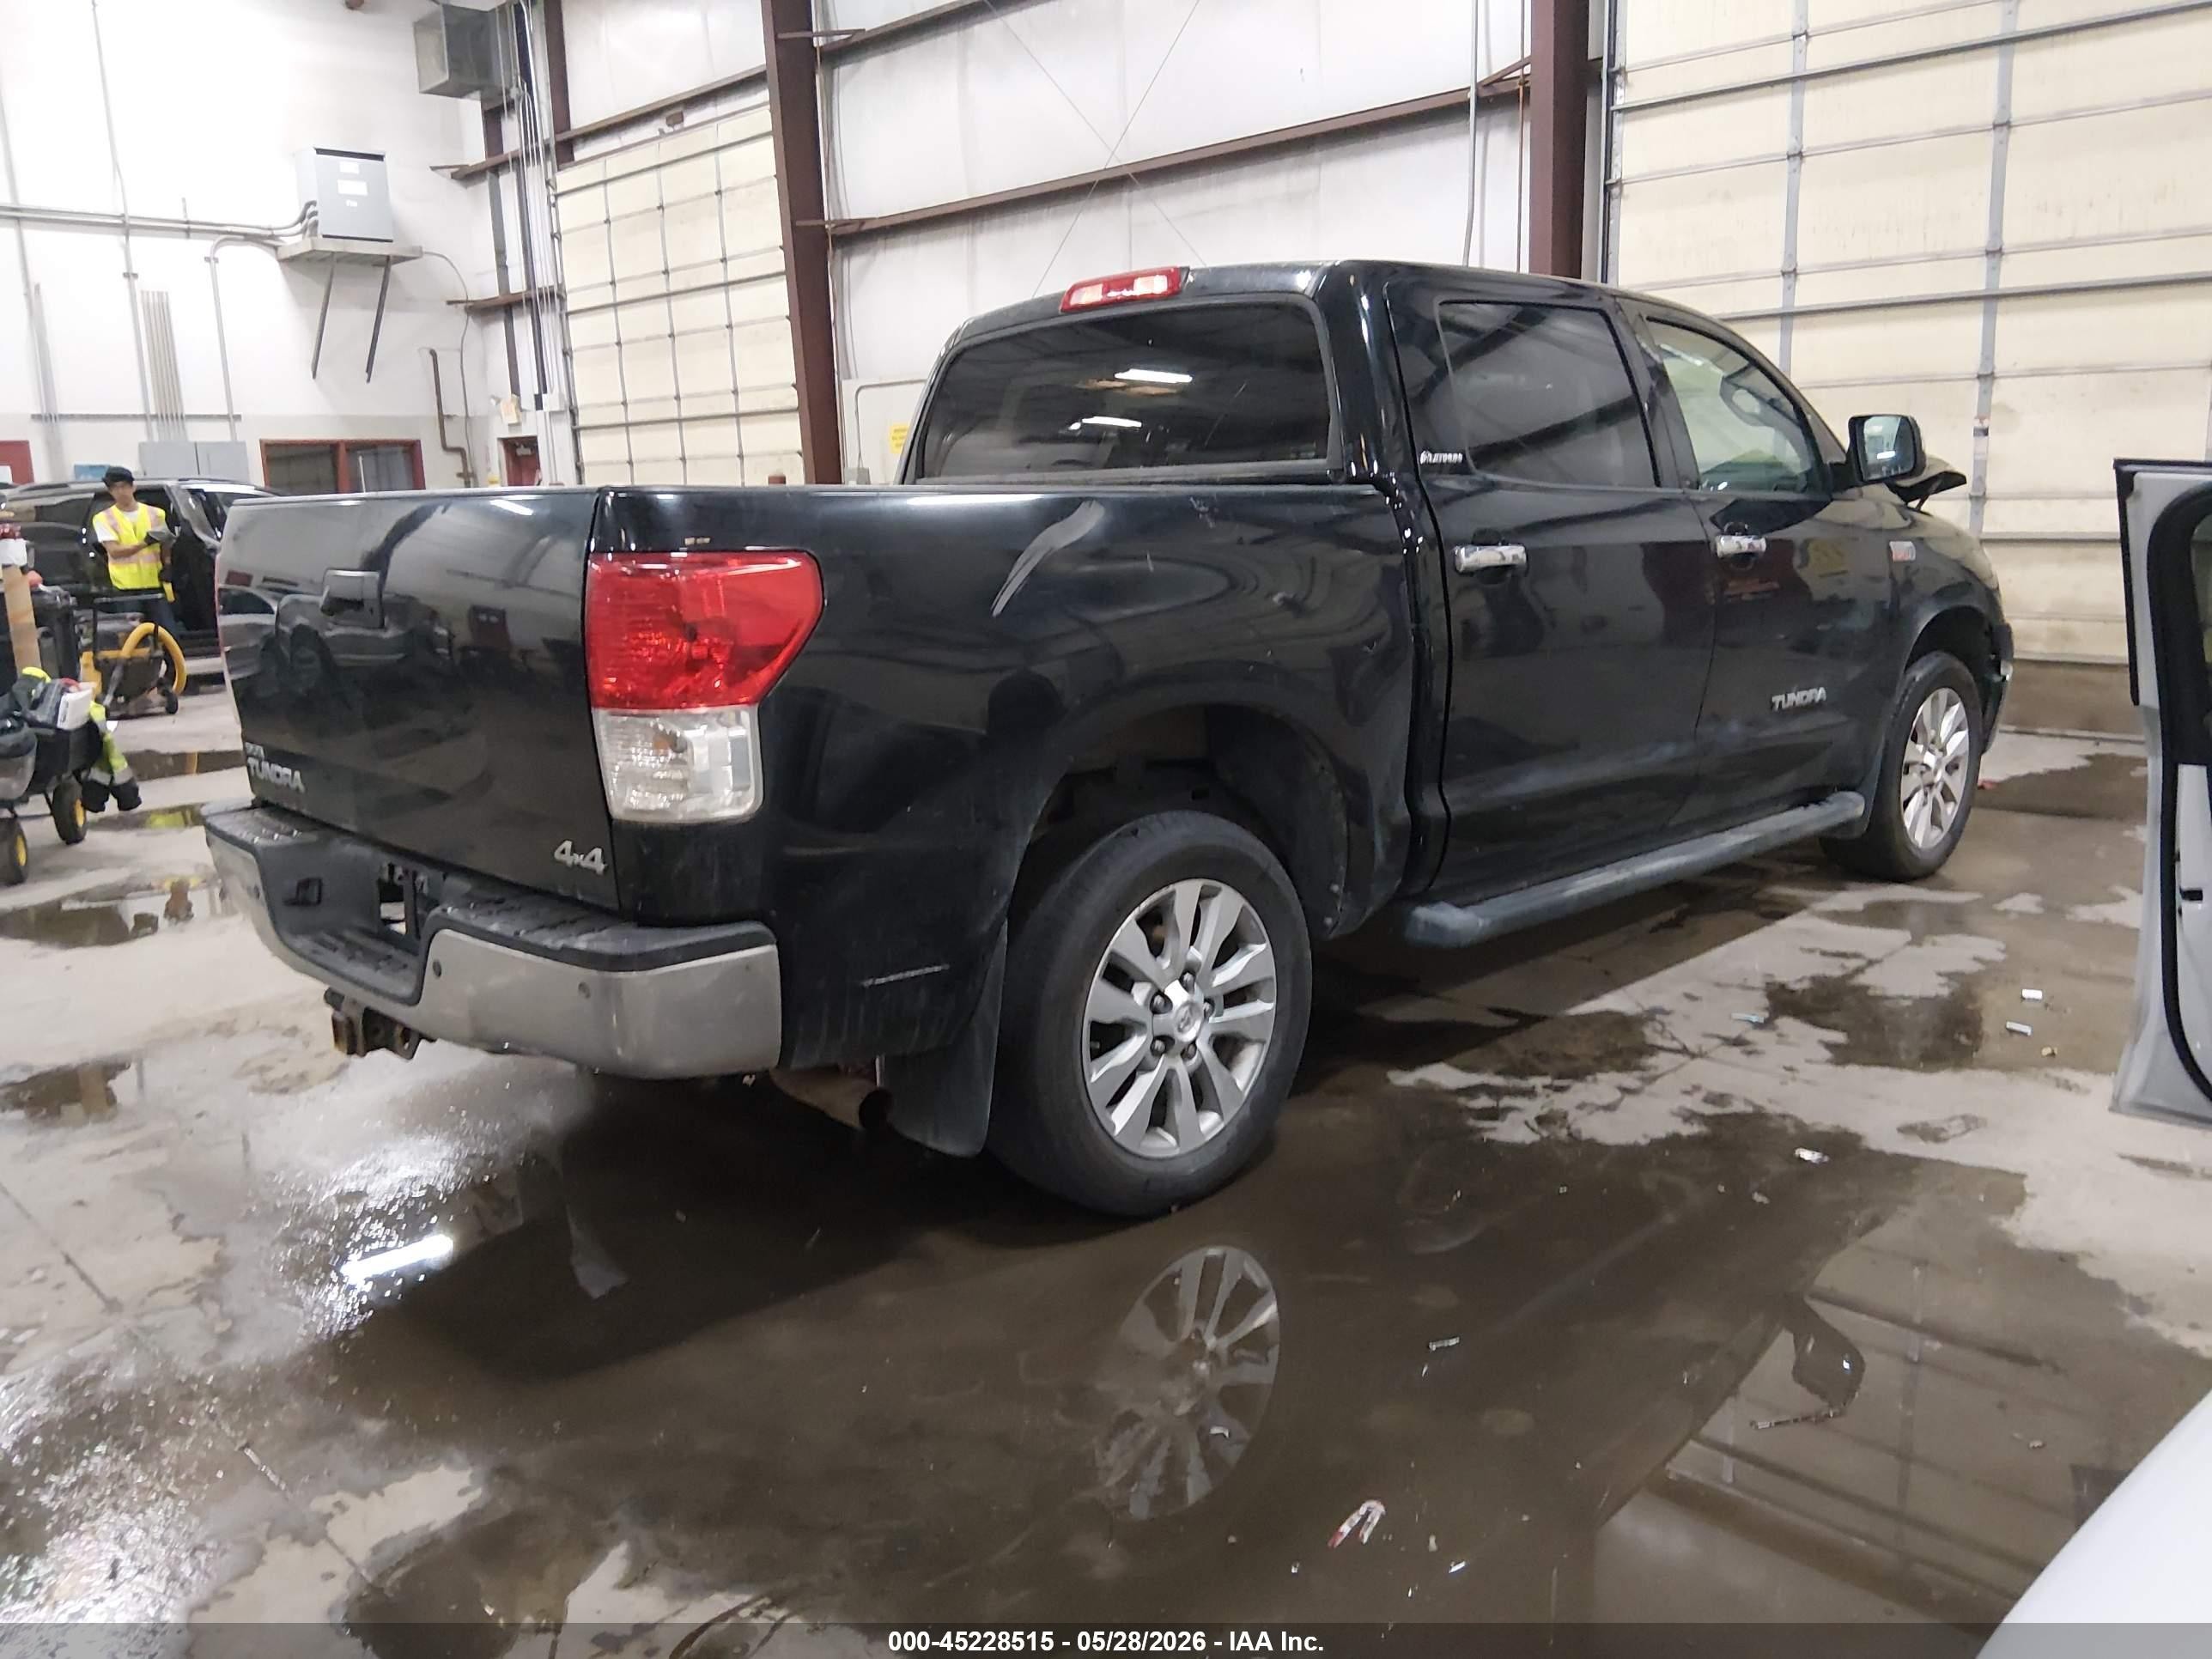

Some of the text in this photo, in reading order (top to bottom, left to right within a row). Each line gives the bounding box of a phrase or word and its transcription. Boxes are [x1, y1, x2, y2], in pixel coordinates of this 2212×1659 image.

[1771, 686, 1827, 711] TUNDRA
[246, 757, 305, 793] TUNDRA
[554, 840, 605, 875] 4x4
